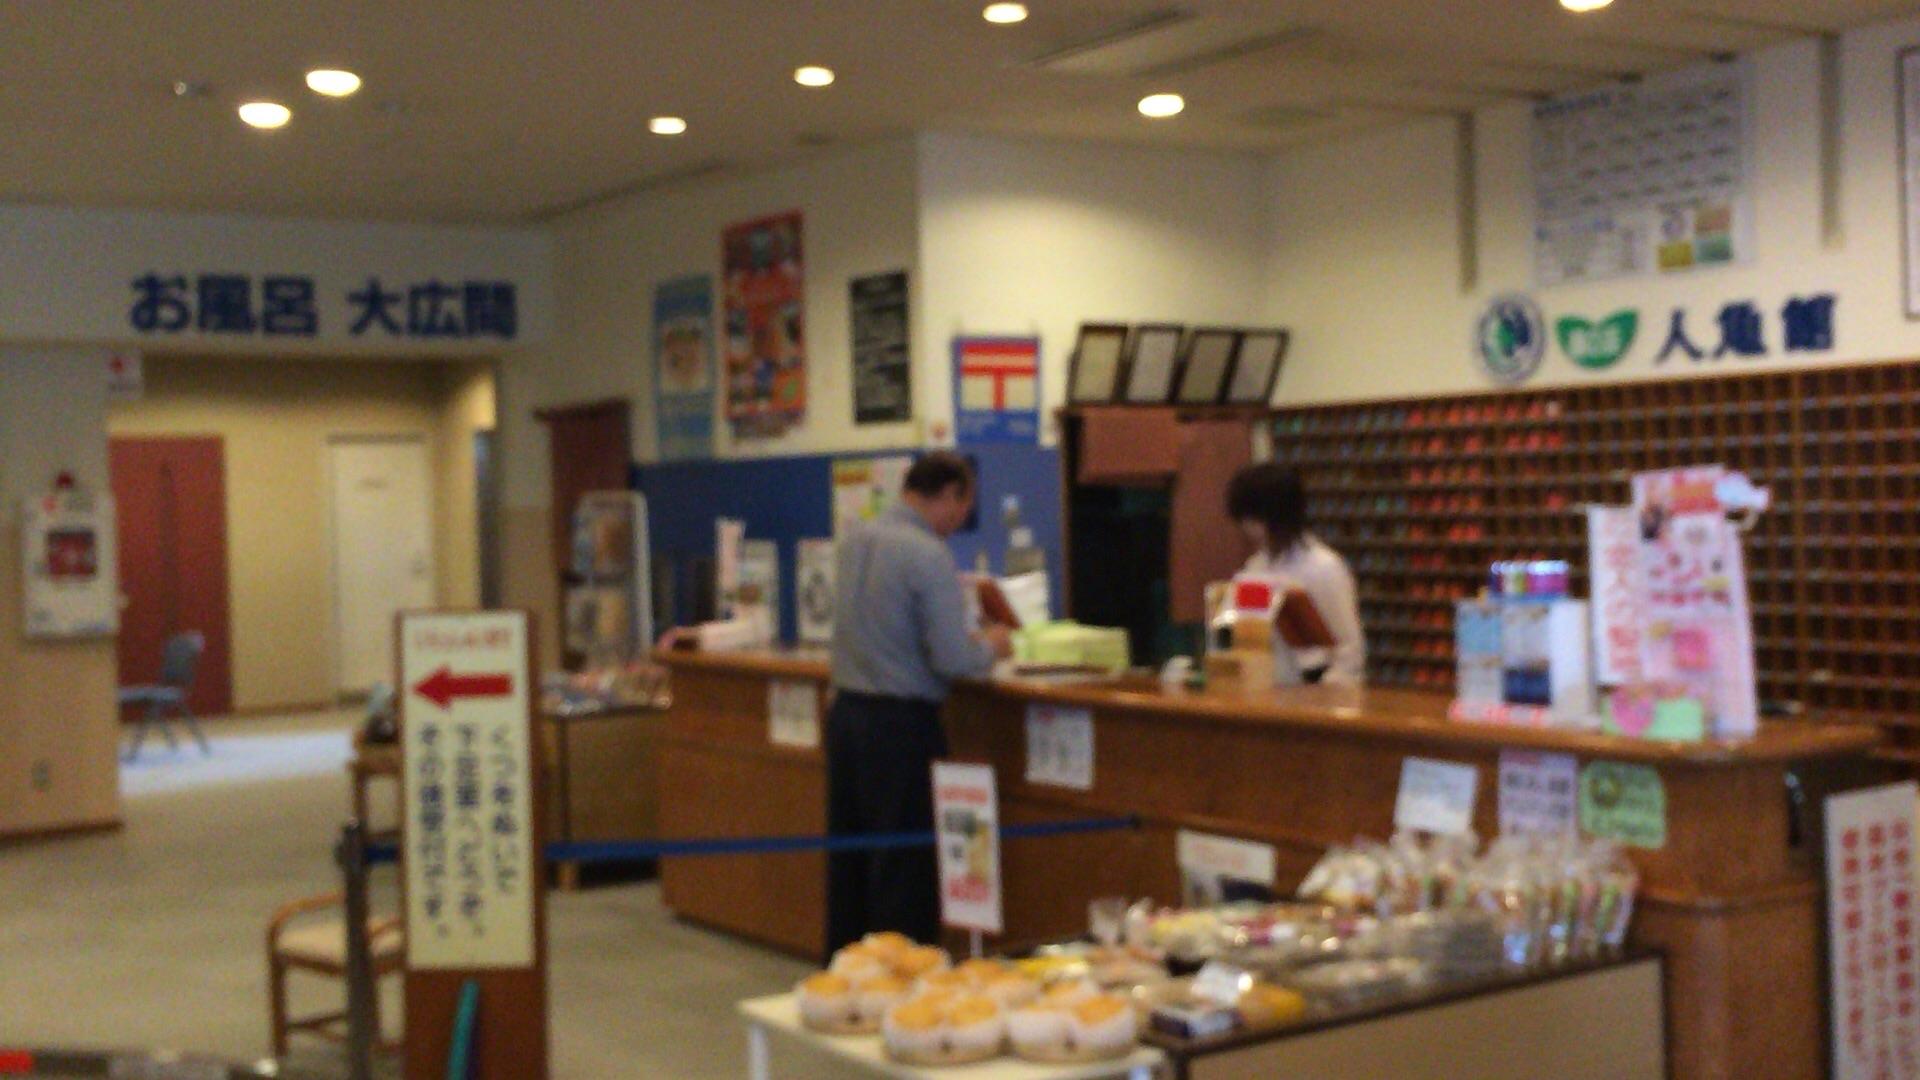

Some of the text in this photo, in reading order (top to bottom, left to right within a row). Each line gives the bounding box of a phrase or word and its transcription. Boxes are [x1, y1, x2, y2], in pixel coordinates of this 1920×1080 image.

[130, 274, 518, 339] お風呂 大広間
